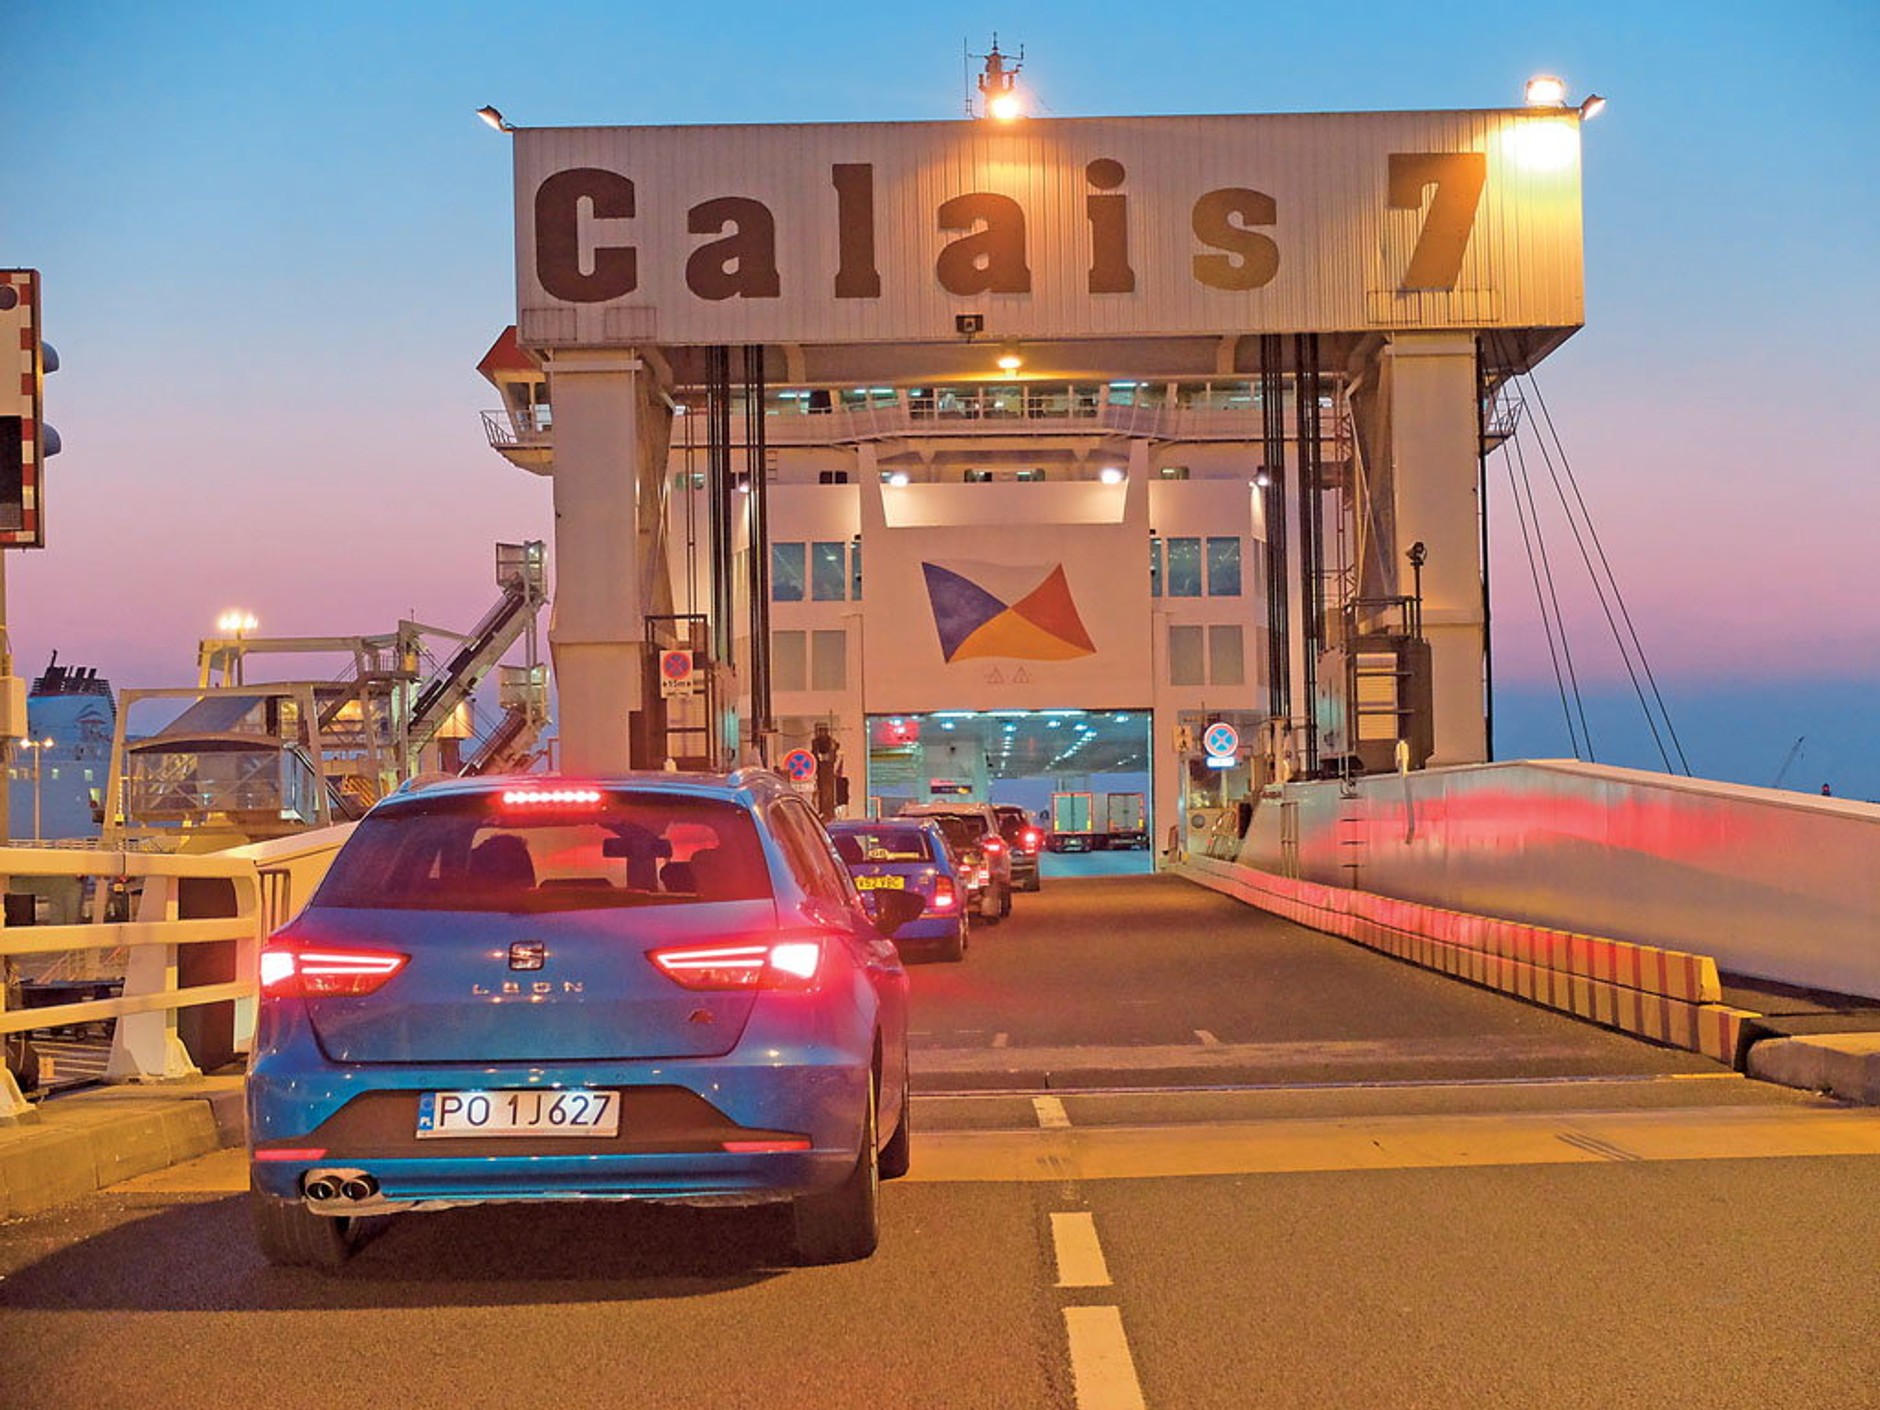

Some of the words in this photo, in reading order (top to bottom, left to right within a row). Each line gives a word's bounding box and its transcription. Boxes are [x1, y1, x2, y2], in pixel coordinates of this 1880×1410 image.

[534, 157, 1280, 304] Calais
[1386, 152, 1486, 292] 7
[472, 981, 584, 995] LEON
[439, 1095, 490, 1127] PO
[507, 1094, 612, 1126] 1J627
